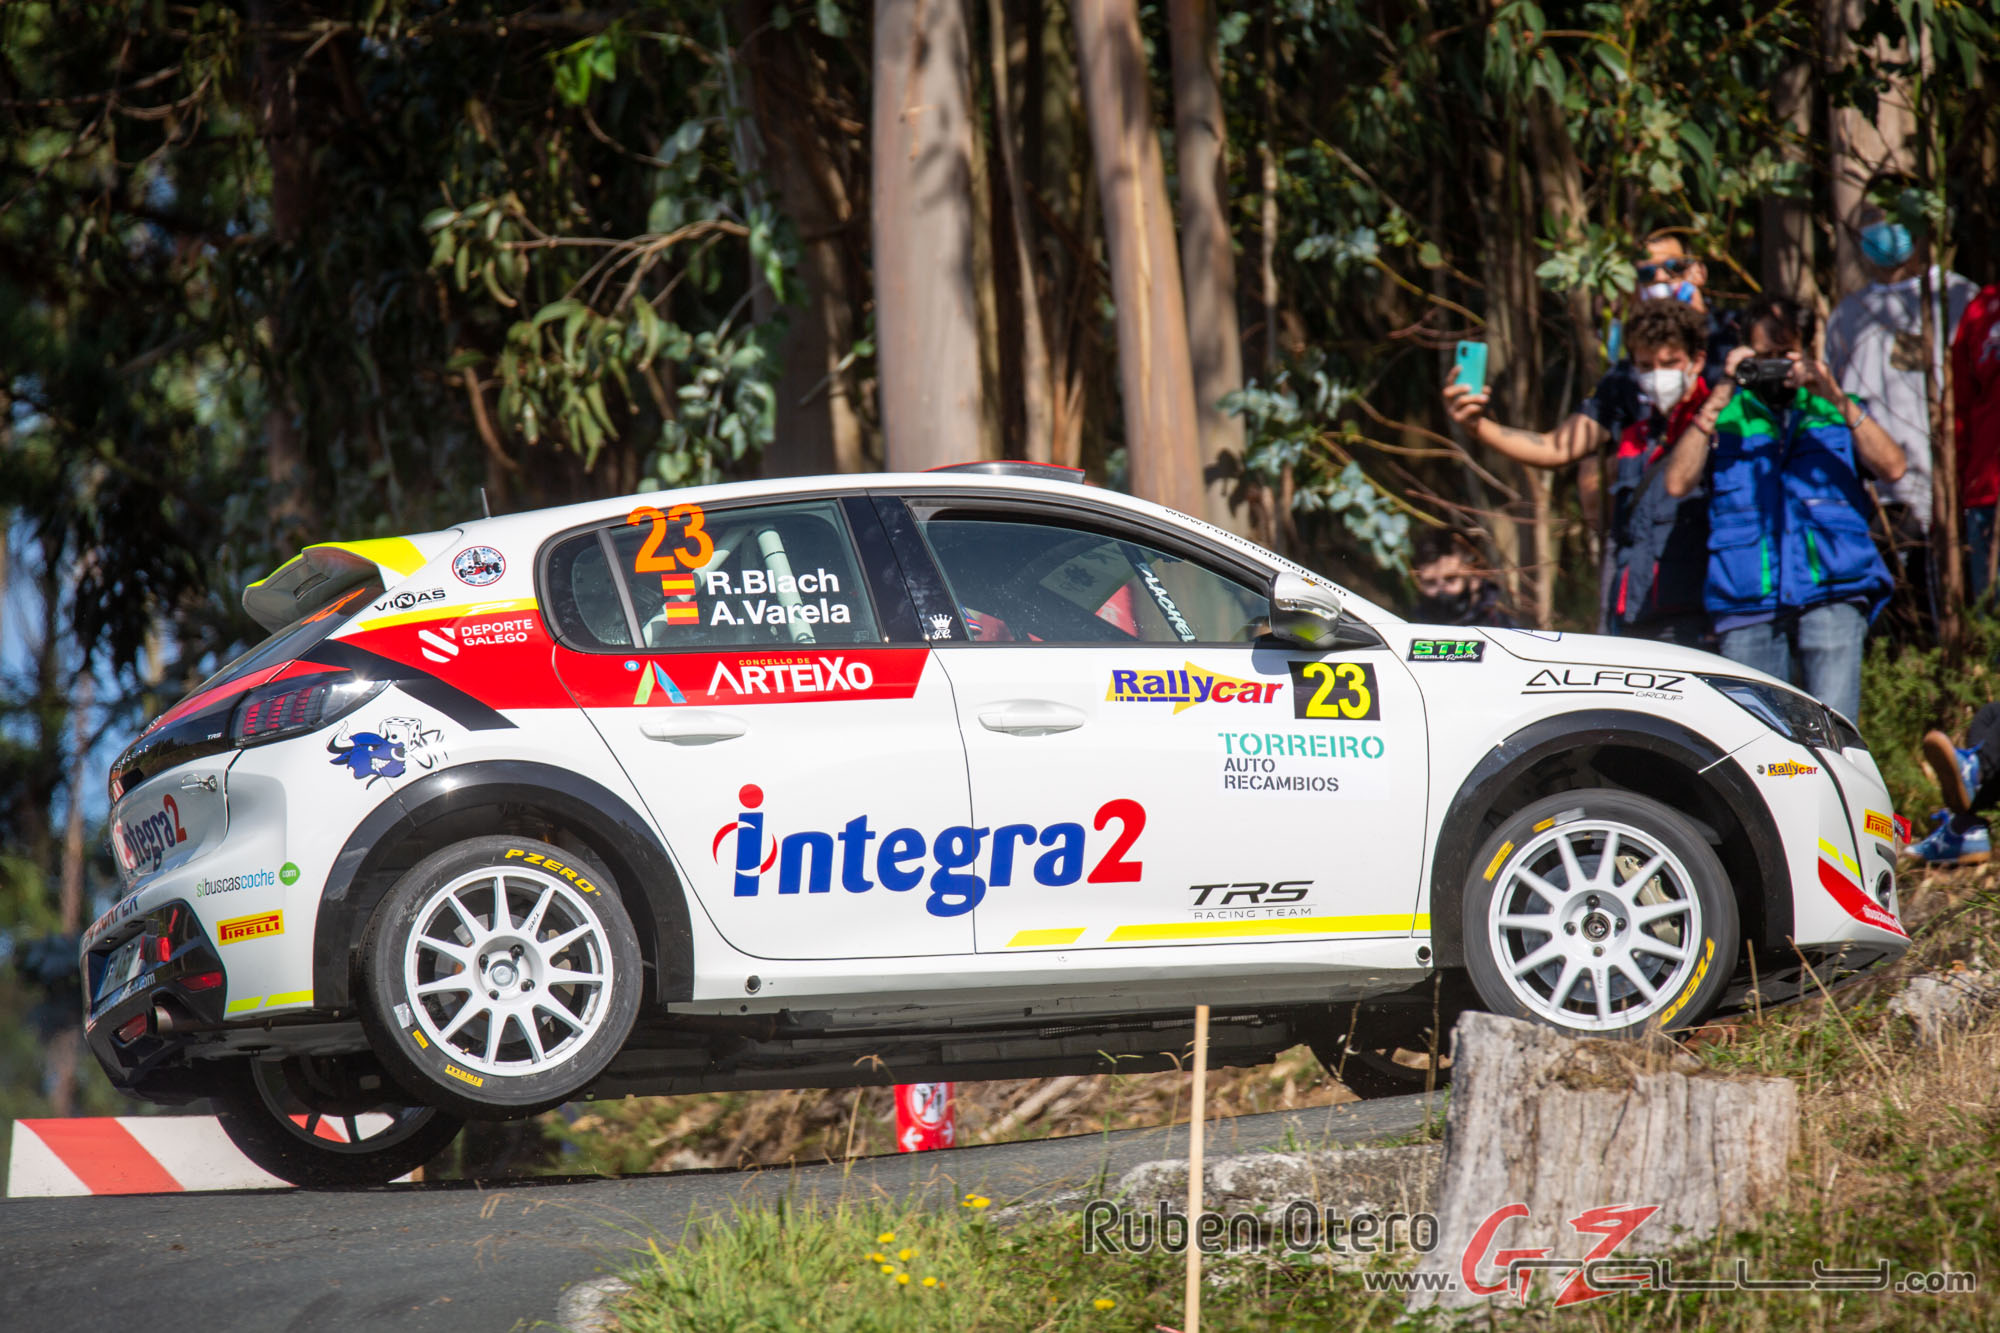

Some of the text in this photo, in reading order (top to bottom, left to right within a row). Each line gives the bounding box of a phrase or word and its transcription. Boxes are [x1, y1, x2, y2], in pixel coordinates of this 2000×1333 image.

[627, 504, 714, 573] 23
[706, 568, 840, 595] R.Blach
[710, 598, 851, 626] A.Varela
[461, 619, 534, 636] DEPORTE
[464, 632, 527, 646] GALEGO
[1413, 641, 1478, 655] STK
[738, 656, 811, 666] CONCELLO DE
[707, 657, 873, 695] ARTEIXO
[1113, 669, 1284, 704] Rallycar
[1526, 670, 1686, 693] ALFOZ
[1303, 662, 1371, 719] 23
[1635, 691, 1684, 701] GROUP
[1218, 733, 1384, 759] TORREIRO
[1224, 758, 1275, 773] AUTO
[1768, 763, 1818, 777] Rallycar
[1224, 775, 1339, 792] RECAMBIOS
[712, 784, 1147, 918] integra2
[196, 868, 274, 897] sibuscascoche
[1189, 880, 1314, 906] TRS
[1194, 907, 1312, 920] RACING TEAM
[220, 915, 279, 940] PIRELLI
